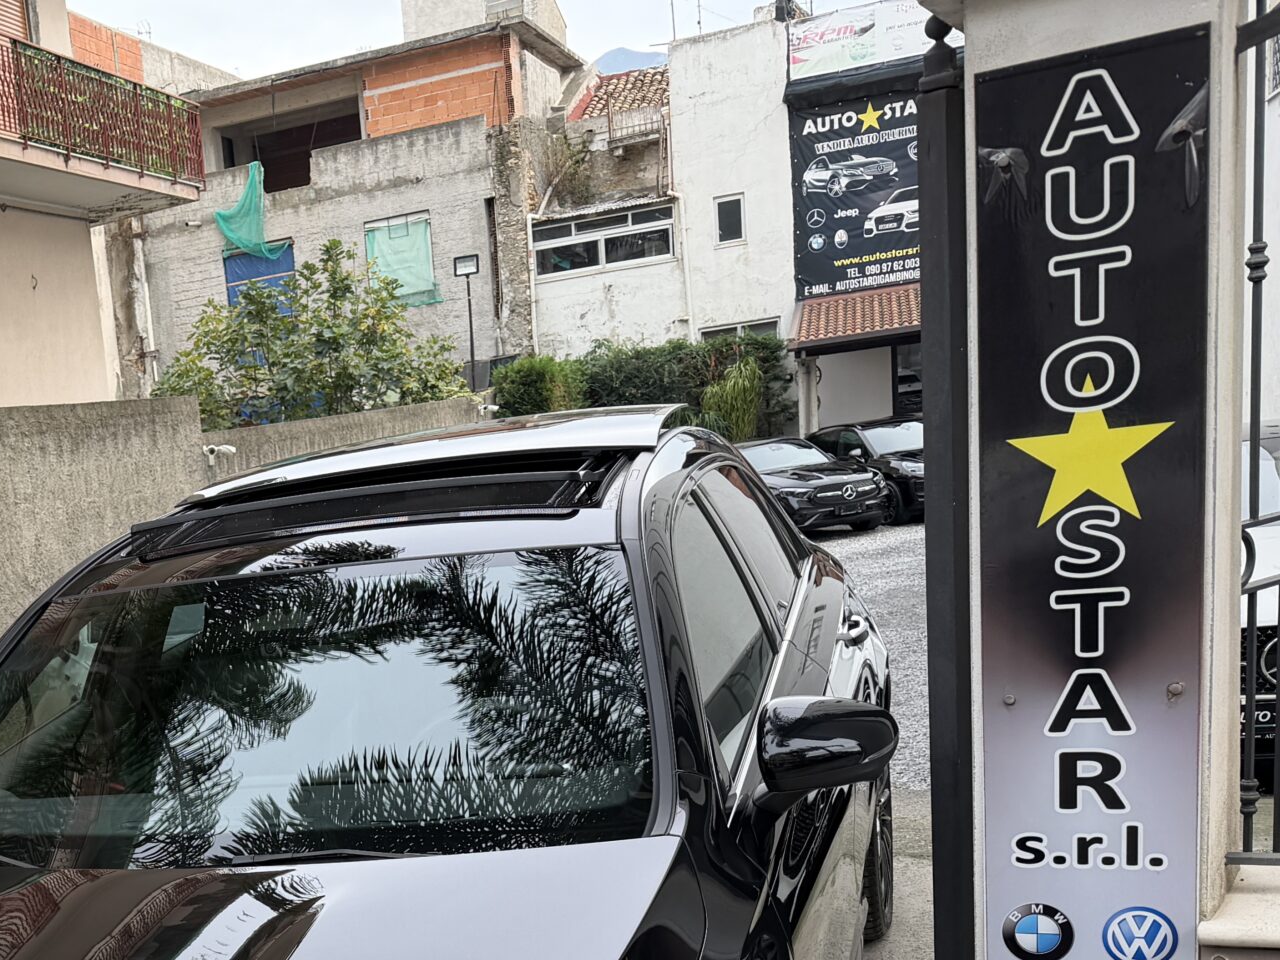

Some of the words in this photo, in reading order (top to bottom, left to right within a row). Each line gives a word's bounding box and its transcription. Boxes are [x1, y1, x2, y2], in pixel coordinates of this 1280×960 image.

[802, 111, 858, 136] AUTO
[814, 138, 853, 154] VENDITA
[853, 133, 880, 149] AUTO
[833, 208, 859, 219] Jeep
[1040, 68, 1140, 413] AUTO
[846, 268, 862, 278] TEL.
[865, 264, 880, 275] 090
[881, 262, 893, 272] 97
[893, 260, 903, 270] 62
[905, 258, 920, 268] 003
[804, 283, 833, 296] E-MAIL:
[1043, 504, 1136, 814] STAR
[1011, 822, 1167, 869] s.r.l.
[1009, 903, 1068, 924] BMW
